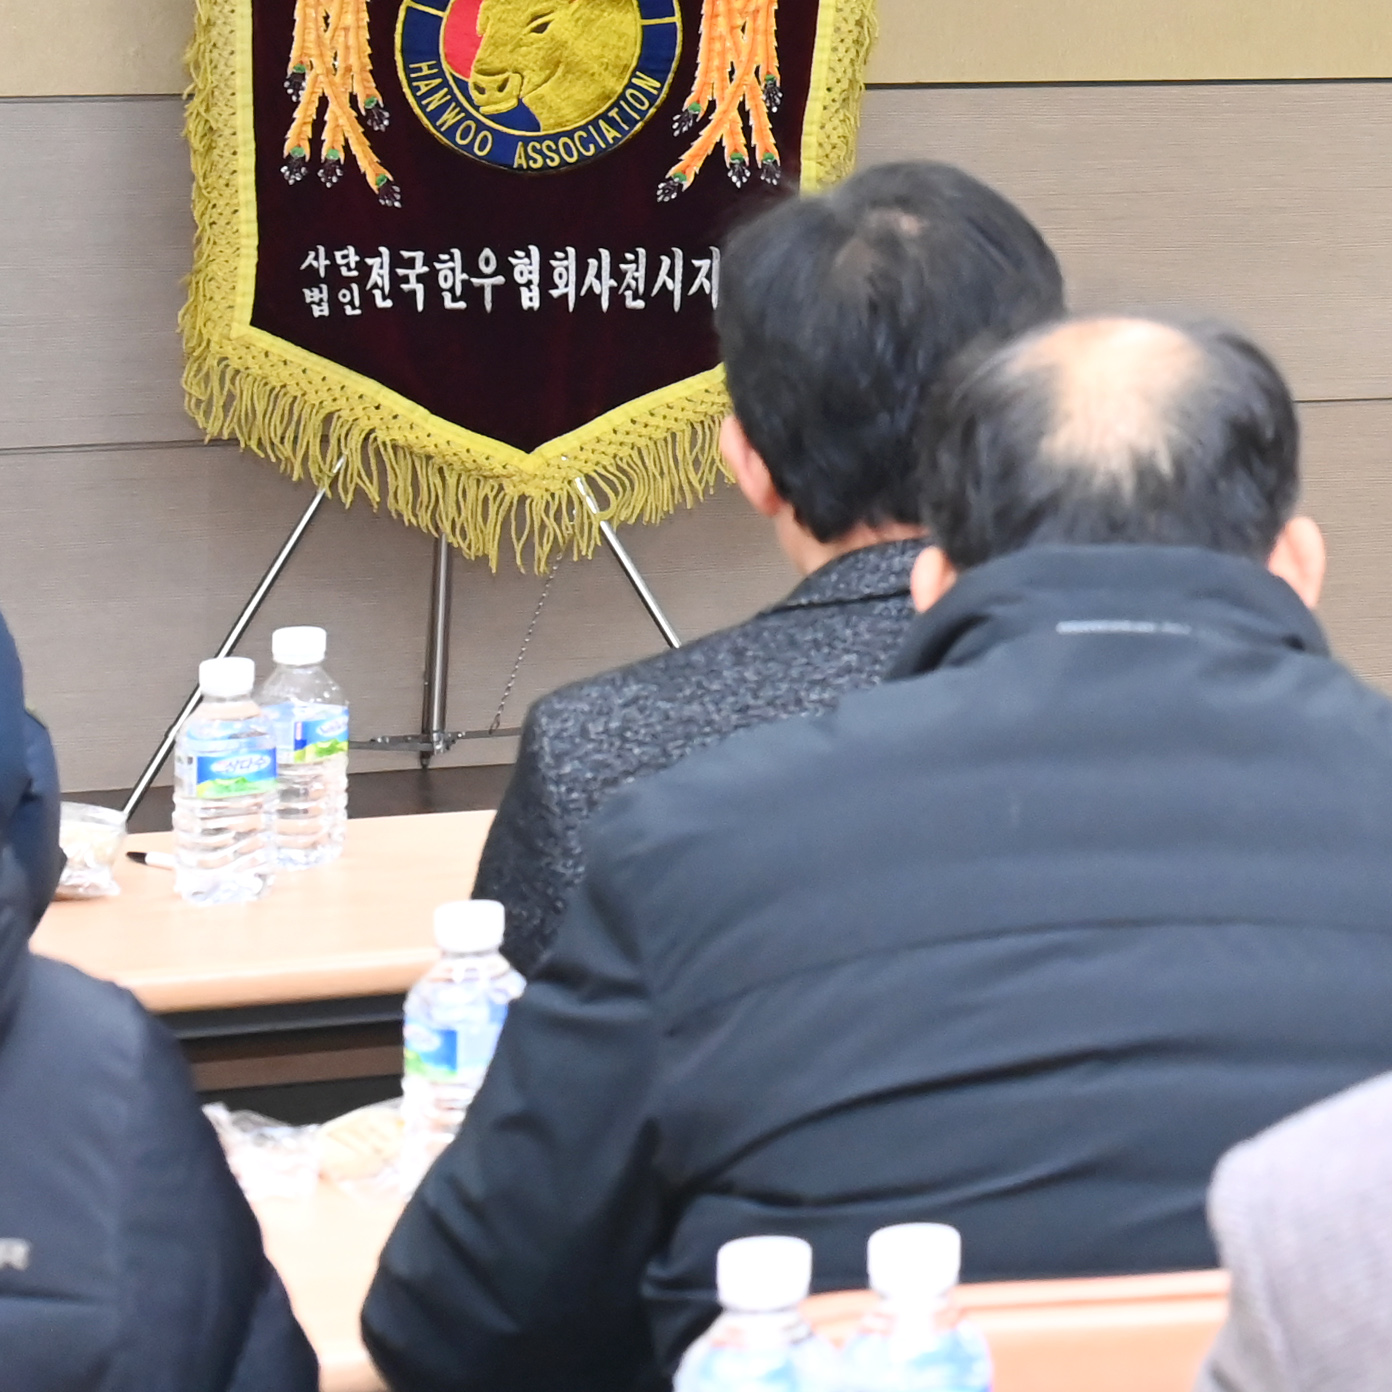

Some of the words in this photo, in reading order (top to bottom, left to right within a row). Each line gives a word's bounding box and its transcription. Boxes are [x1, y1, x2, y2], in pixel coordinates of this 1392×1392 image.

[409, 60, 493, 157] HANWOO
[513, 70, 662, 170] ASSOCIATION
[300, 245, 360, 278] 사단
[302, 283, 362, 317] 법인
